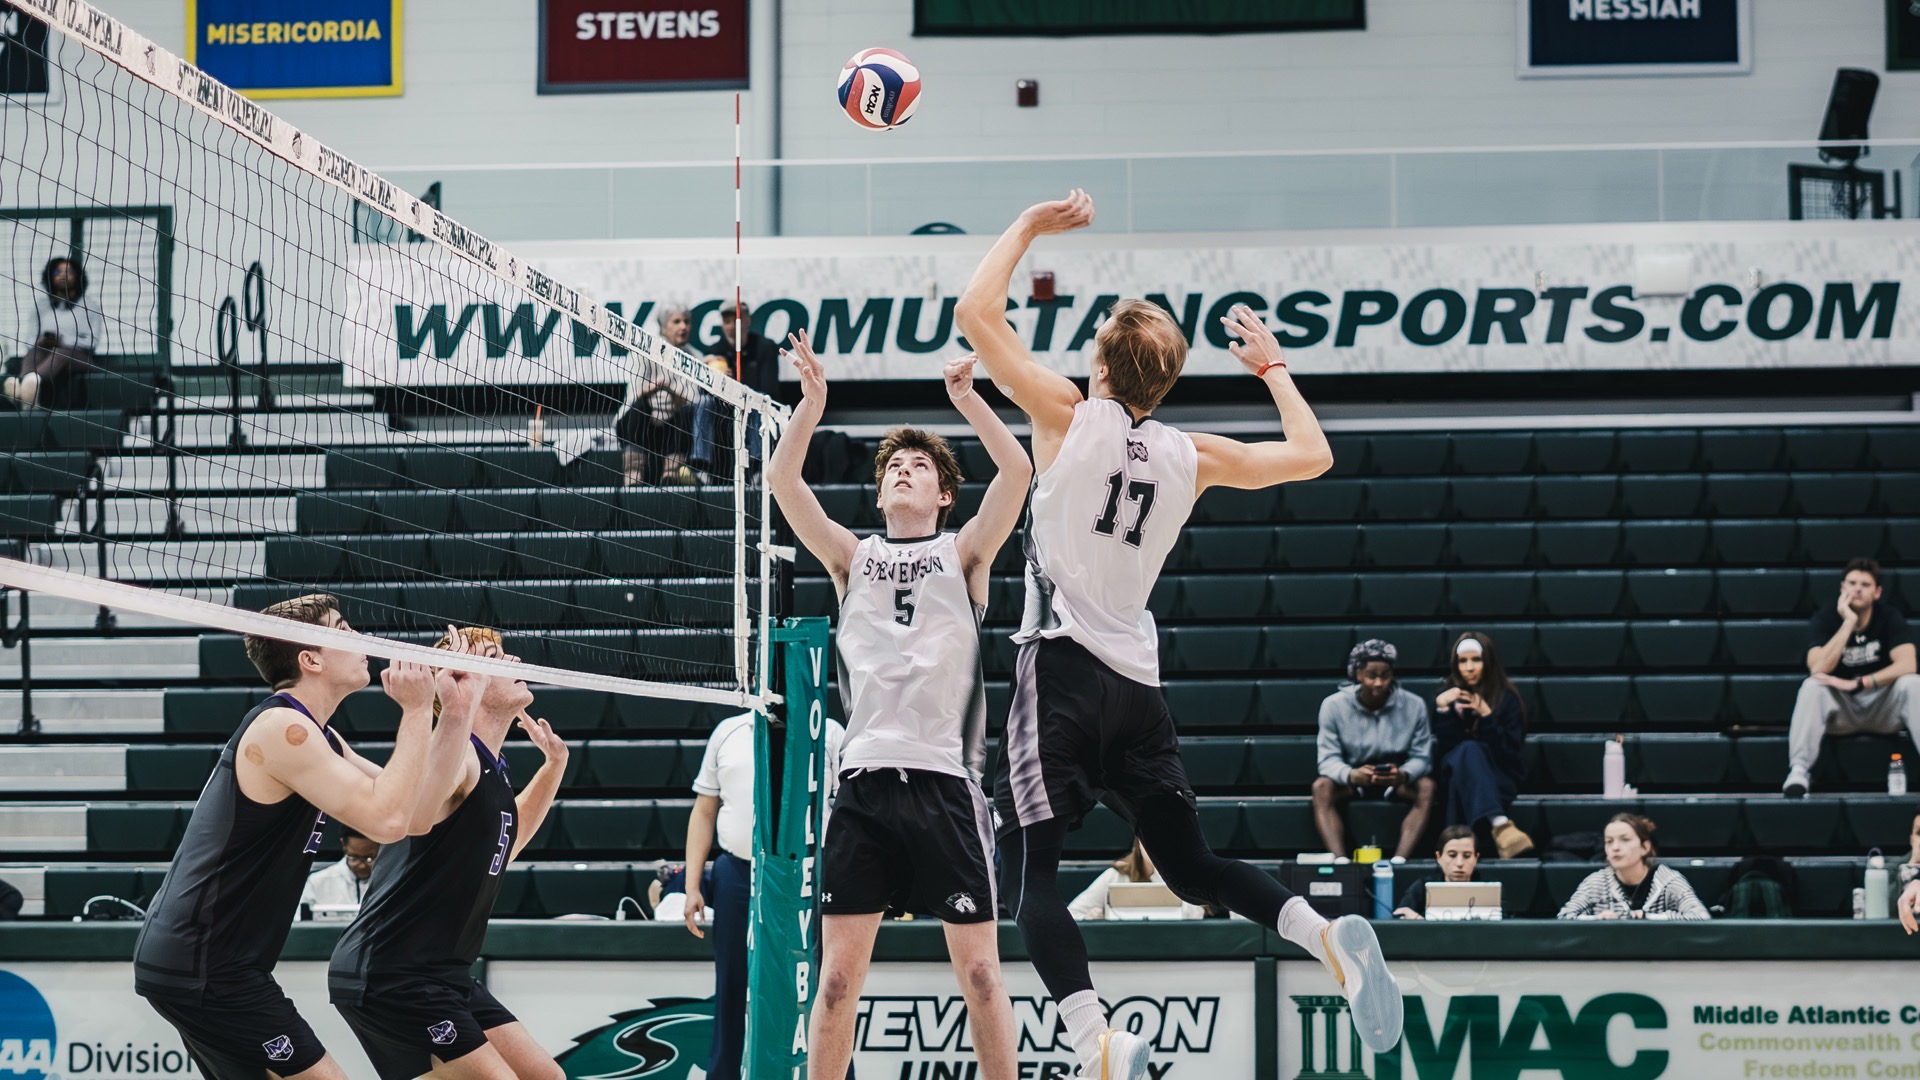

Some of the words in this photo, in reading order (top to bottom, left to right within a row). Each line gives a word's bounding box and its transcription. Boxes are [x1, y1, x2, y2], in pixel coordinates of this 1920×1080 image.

[575, 9, 720, 41] STEVENS
[1568, 0, 1700, 21] MESSIAH
[207, 18, 381, 45] MISERICORDIA
[864, 84, 881, 115] NCAA
[1091, 468, 1158, 550] 17
[863, 556, 944, 583] STEVENSON
[893, 586, 916, 627] 5
[488, 811, 512, 876] 5
[1692, 1005, 1779, 1025] Middle
[1787, 1005, 1891, 1025] Atlantic
[1899, 1005, 1920, 1025] C
[1374, 992, 1669, 1080] MAC
[1699, 1032, 1901, 1051] Commonwealth
[1743, 1060, 1858, 1079] Freedom
